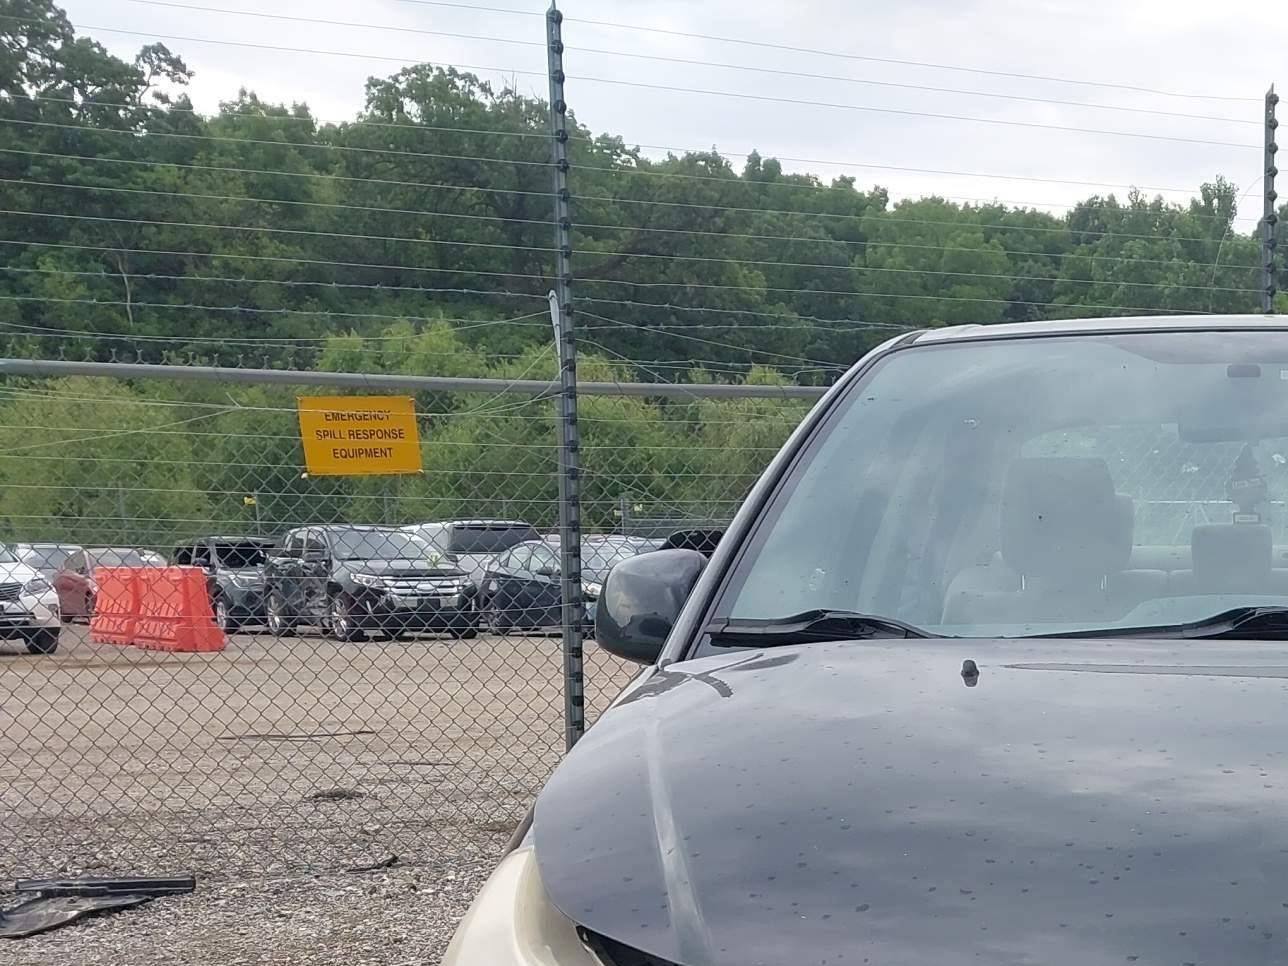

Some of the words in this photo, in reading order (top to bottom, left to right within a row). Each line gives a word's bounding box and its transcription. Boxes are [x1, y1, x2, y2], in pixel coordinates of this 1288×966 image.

[324, 410, 391, 421] EMERGENCY
[315, 429, 346, 440] SPILL
[348, 428, 405, 440] RESPONSE
[332, 447, 393, 459] EQUIPMENT
